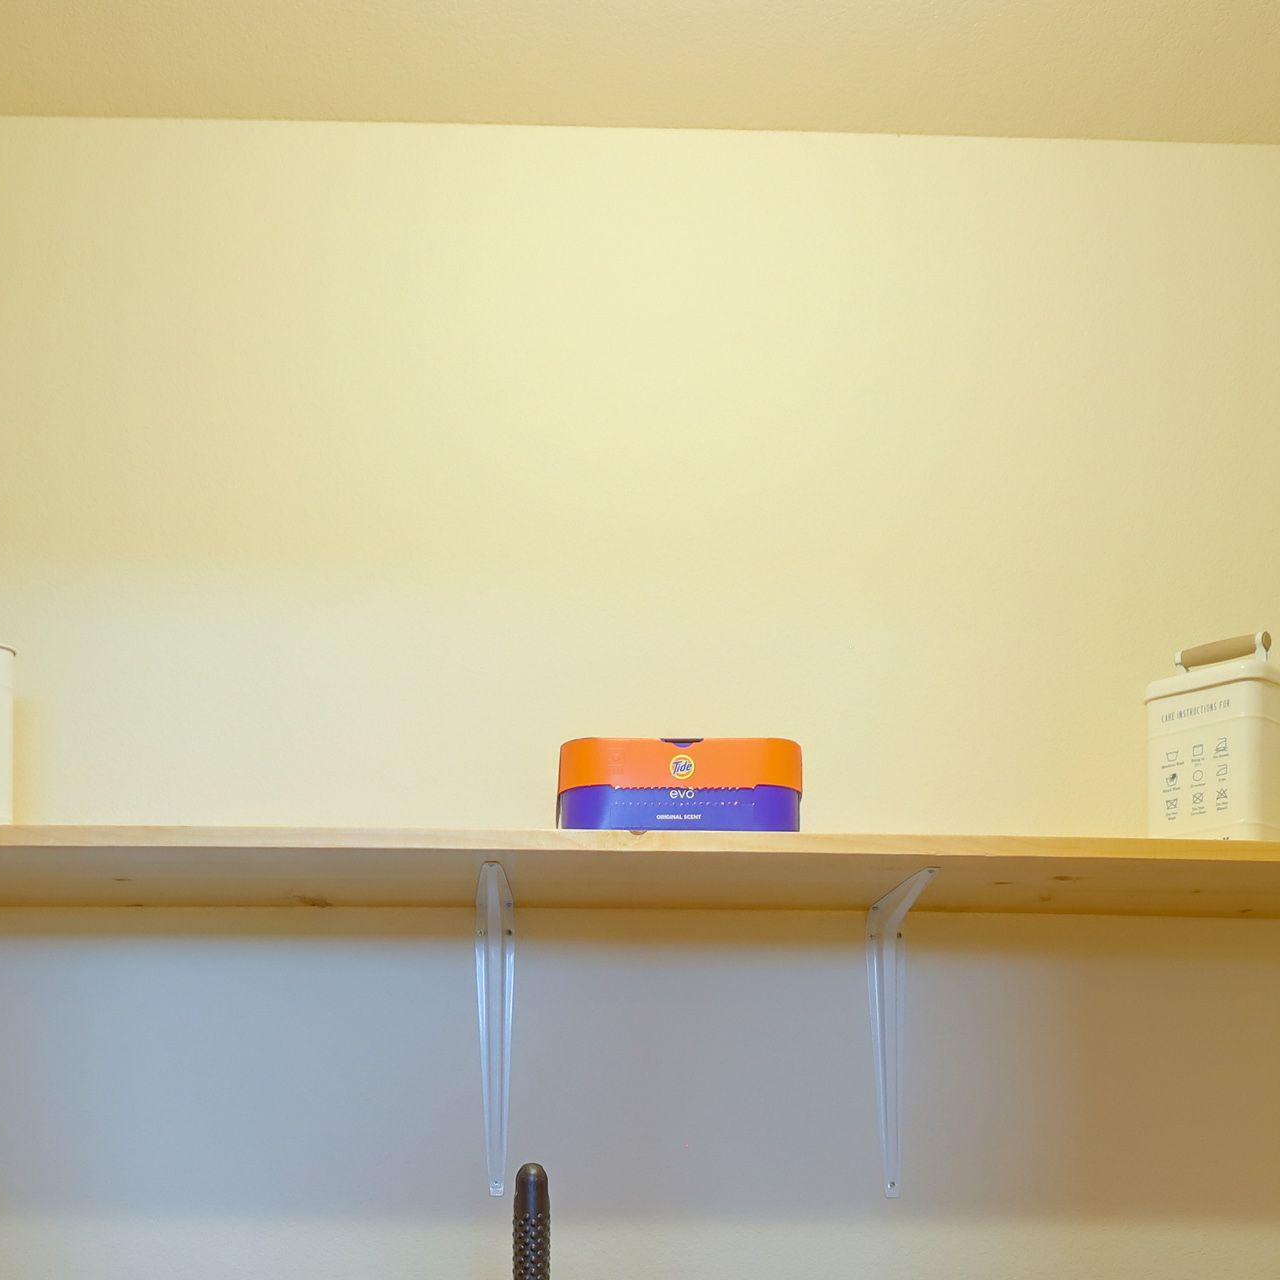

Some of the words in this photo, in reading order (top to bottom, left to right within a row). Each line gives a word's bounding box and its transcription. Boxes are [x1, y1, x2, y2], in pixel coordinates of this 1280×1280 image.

[1161, 712, 1174, 723] CARE
[1177, 702, 1217, 719] INSTRUCTIONS
[1220, 699, 1230, 709] FOR
[672, 760, 692, 774] Tide
[670, 790, 694, 799] evo
